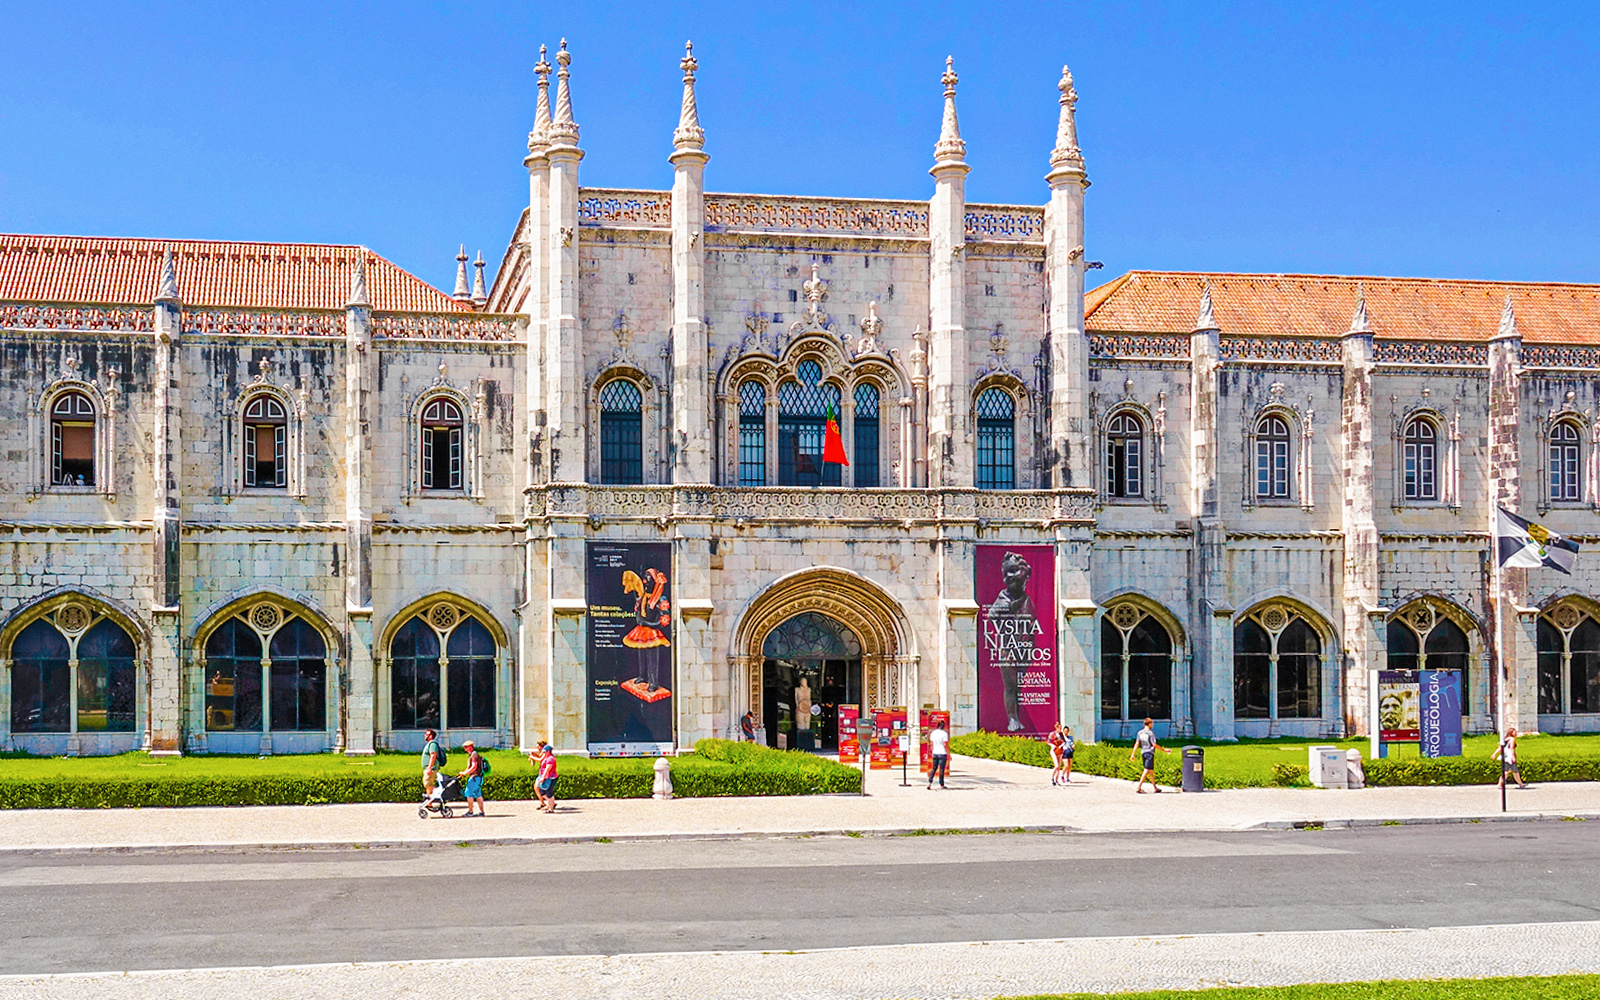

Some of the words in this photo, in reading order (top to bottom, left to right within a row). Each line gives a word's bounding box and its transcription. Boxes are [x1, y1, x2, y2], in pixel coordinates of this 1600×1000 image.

[982, 619, 1043, 634] LVSITA
[984, 633, 1018, 649] NIA
[1429, 672, 1440, 758] ARQUEOLOGIA
